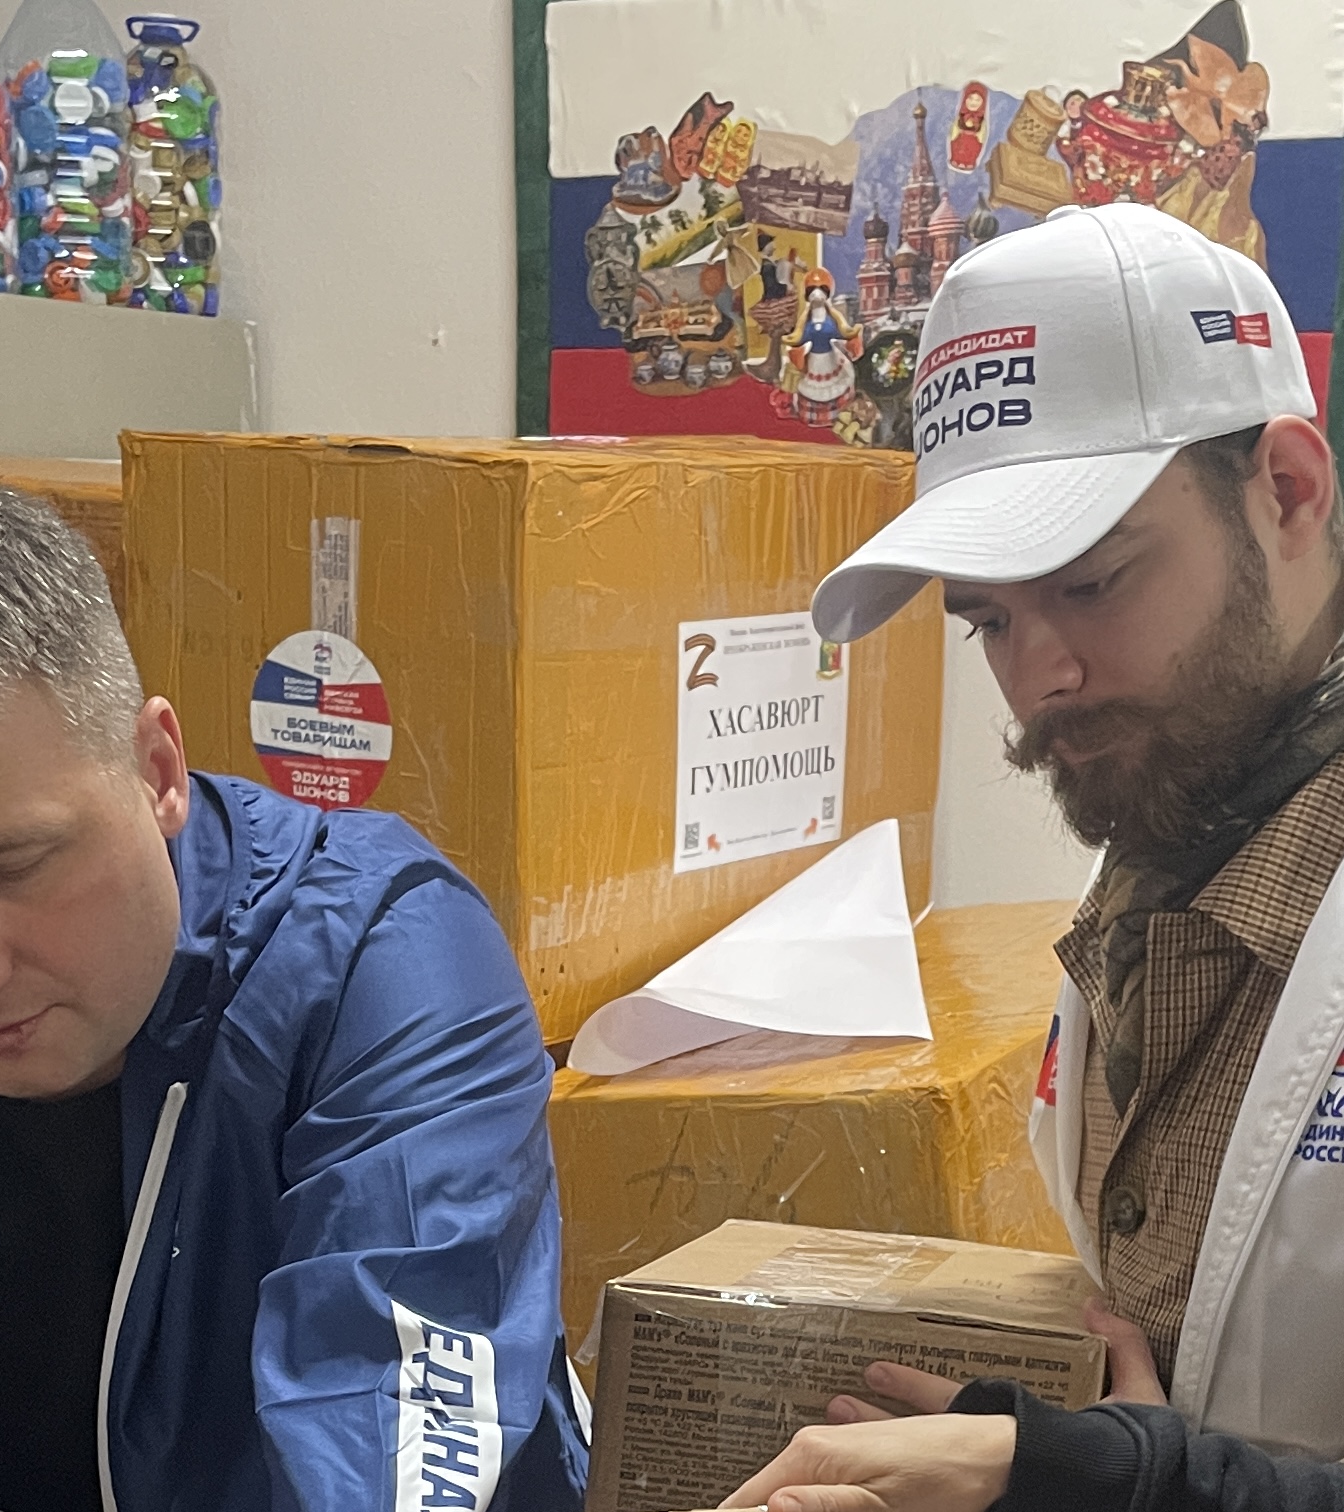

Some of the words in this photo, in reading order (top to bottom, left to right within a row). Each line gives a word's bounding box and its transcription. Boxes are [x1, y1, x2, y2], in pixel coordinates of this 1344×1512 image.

[931, 331, 1027, 367] КАНДИДАТ
[286, 717, 355, 737] БОЕВЫМ
[707, 694, 824, 739] ХАСАВЮРТ
[271, 728, 371, 752] ТОВАРИЩАМ
[291, 770, 350, 790] ЭДУАРД
[690, 745, 836, 796] ГУМПОМОЩЬ
[293, 785, 350, 803] ШОНОВ
